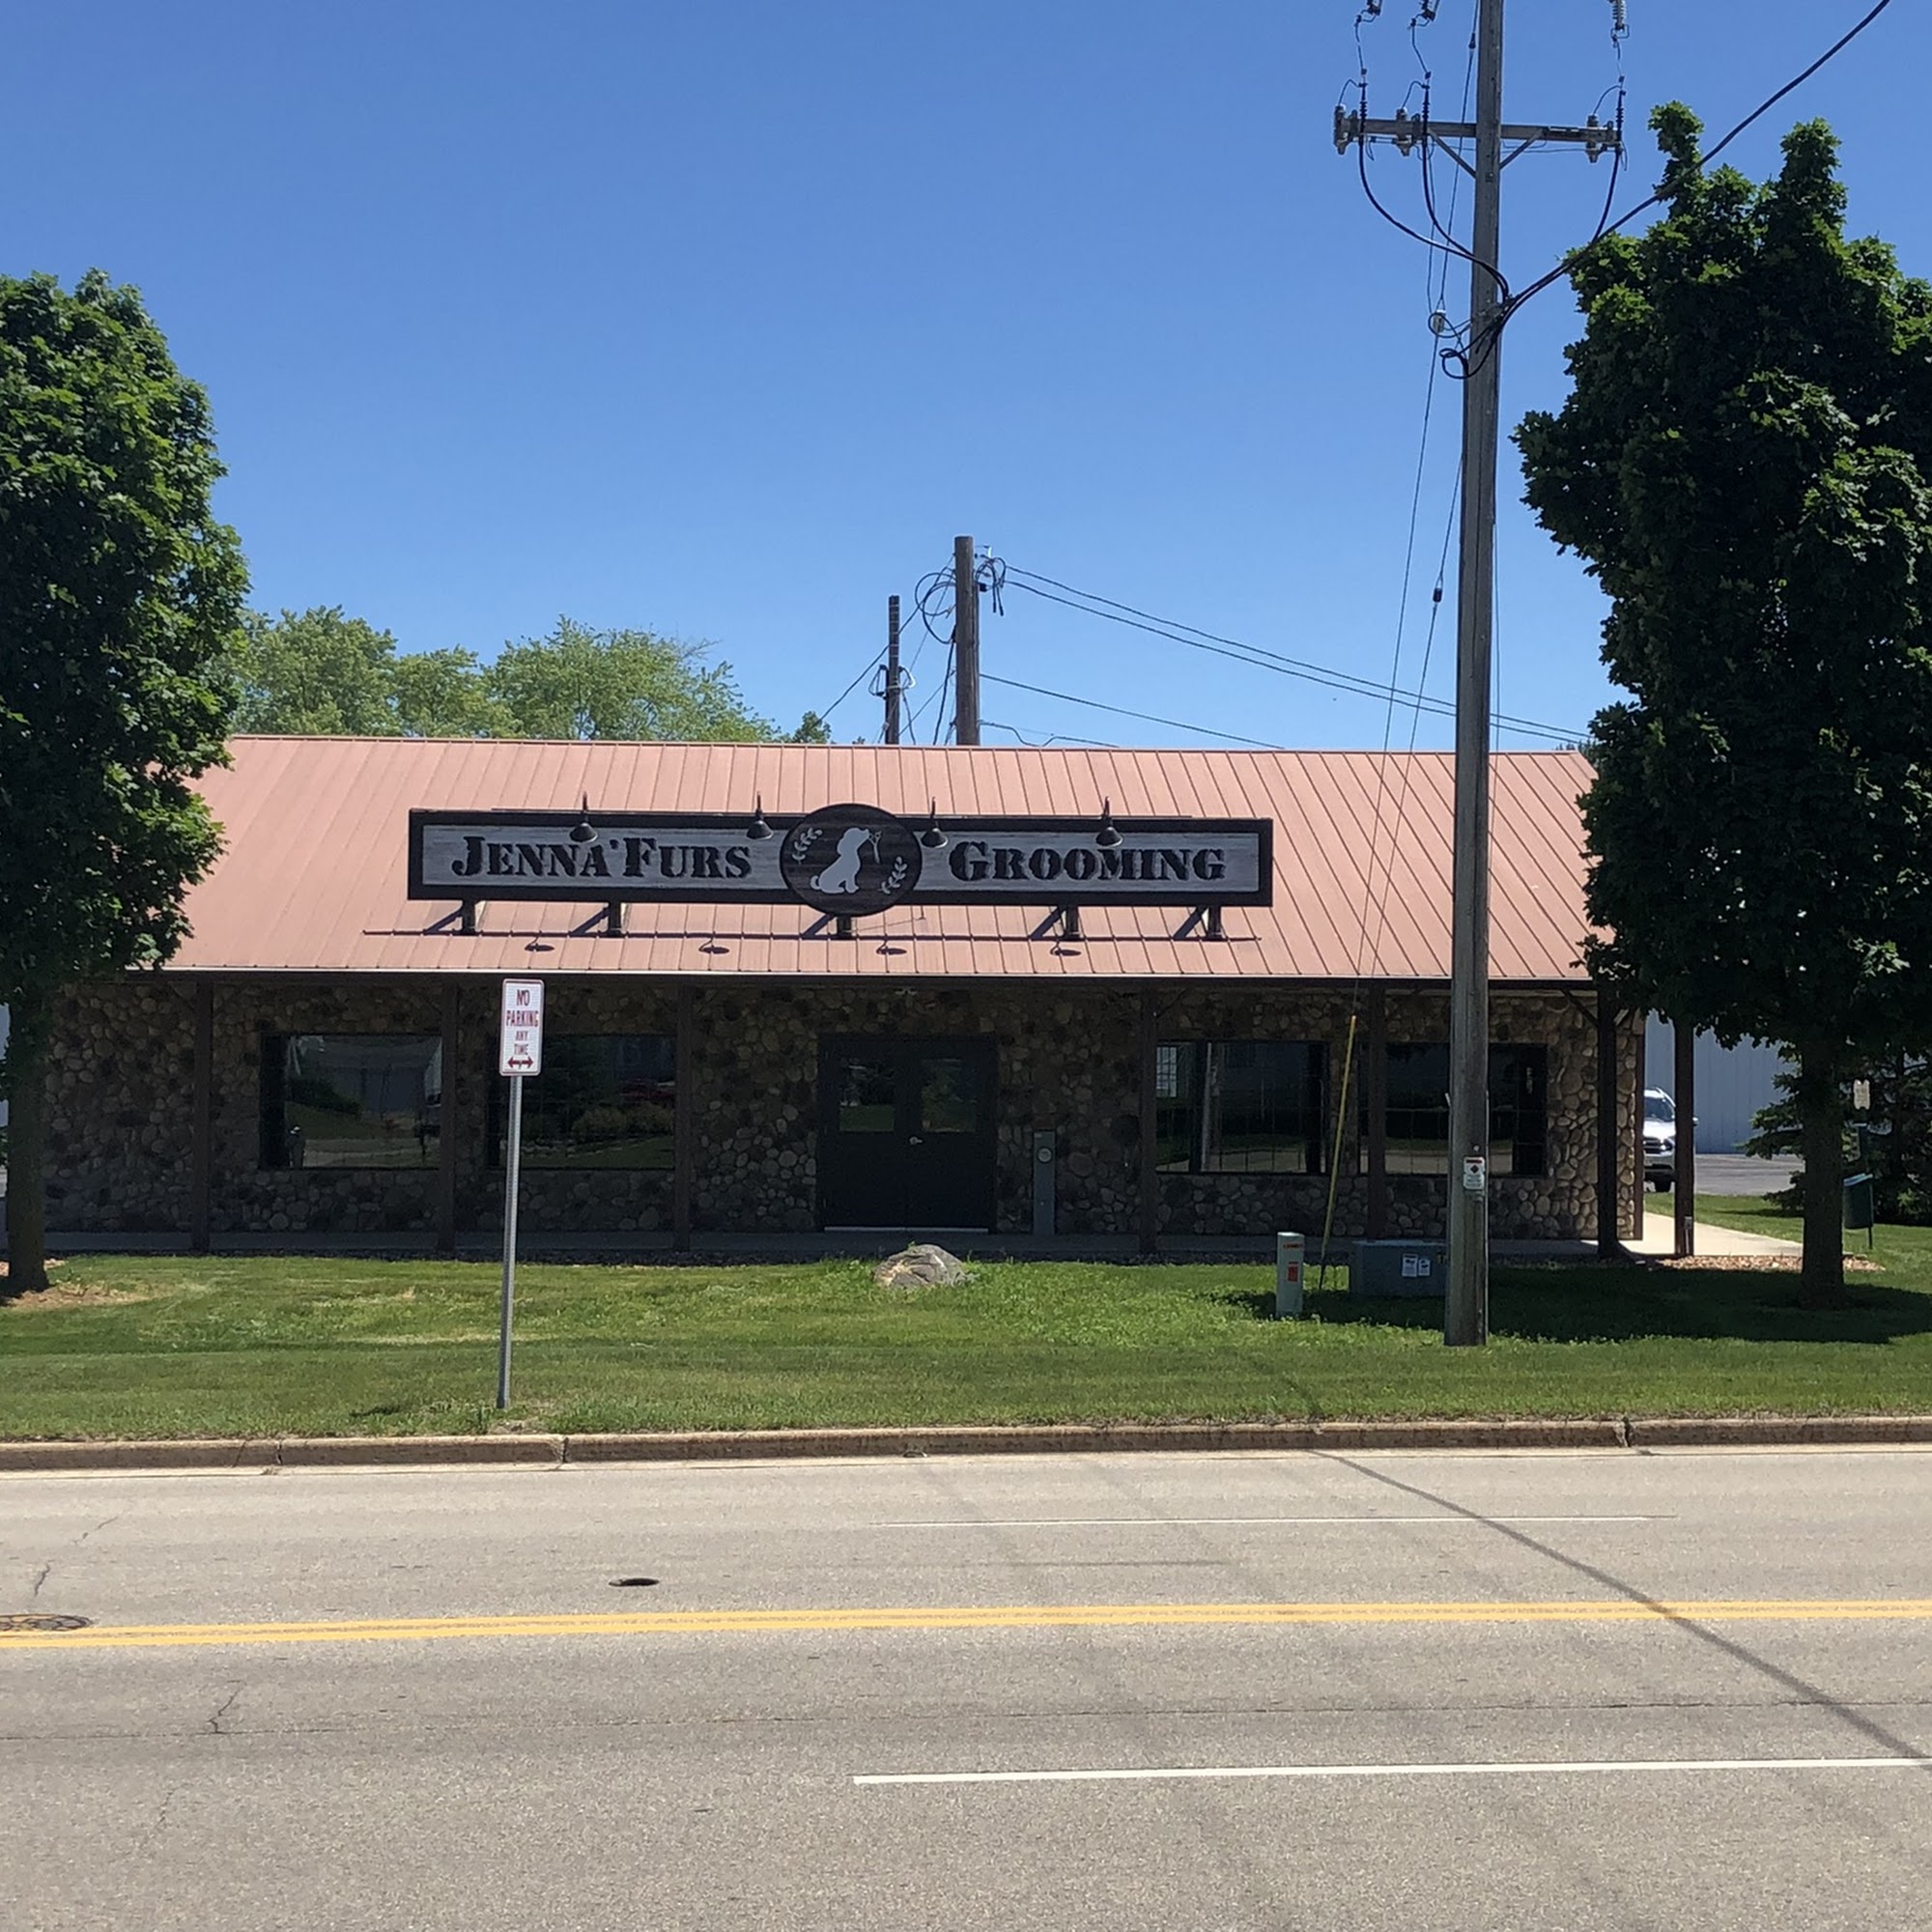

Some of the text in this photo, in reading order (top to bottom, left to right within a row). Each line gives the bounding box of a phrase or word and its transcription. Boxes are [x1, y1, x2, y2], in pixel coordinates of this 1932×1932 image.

[949, 841, 1226, 881] GROOMING
[516, 989, 530, 1007] NO
[506, 1010, 538, 1027] PARKING
[515, 1031, 528, 1041] ANY
[514, 1043, 528, 1056] TIME
